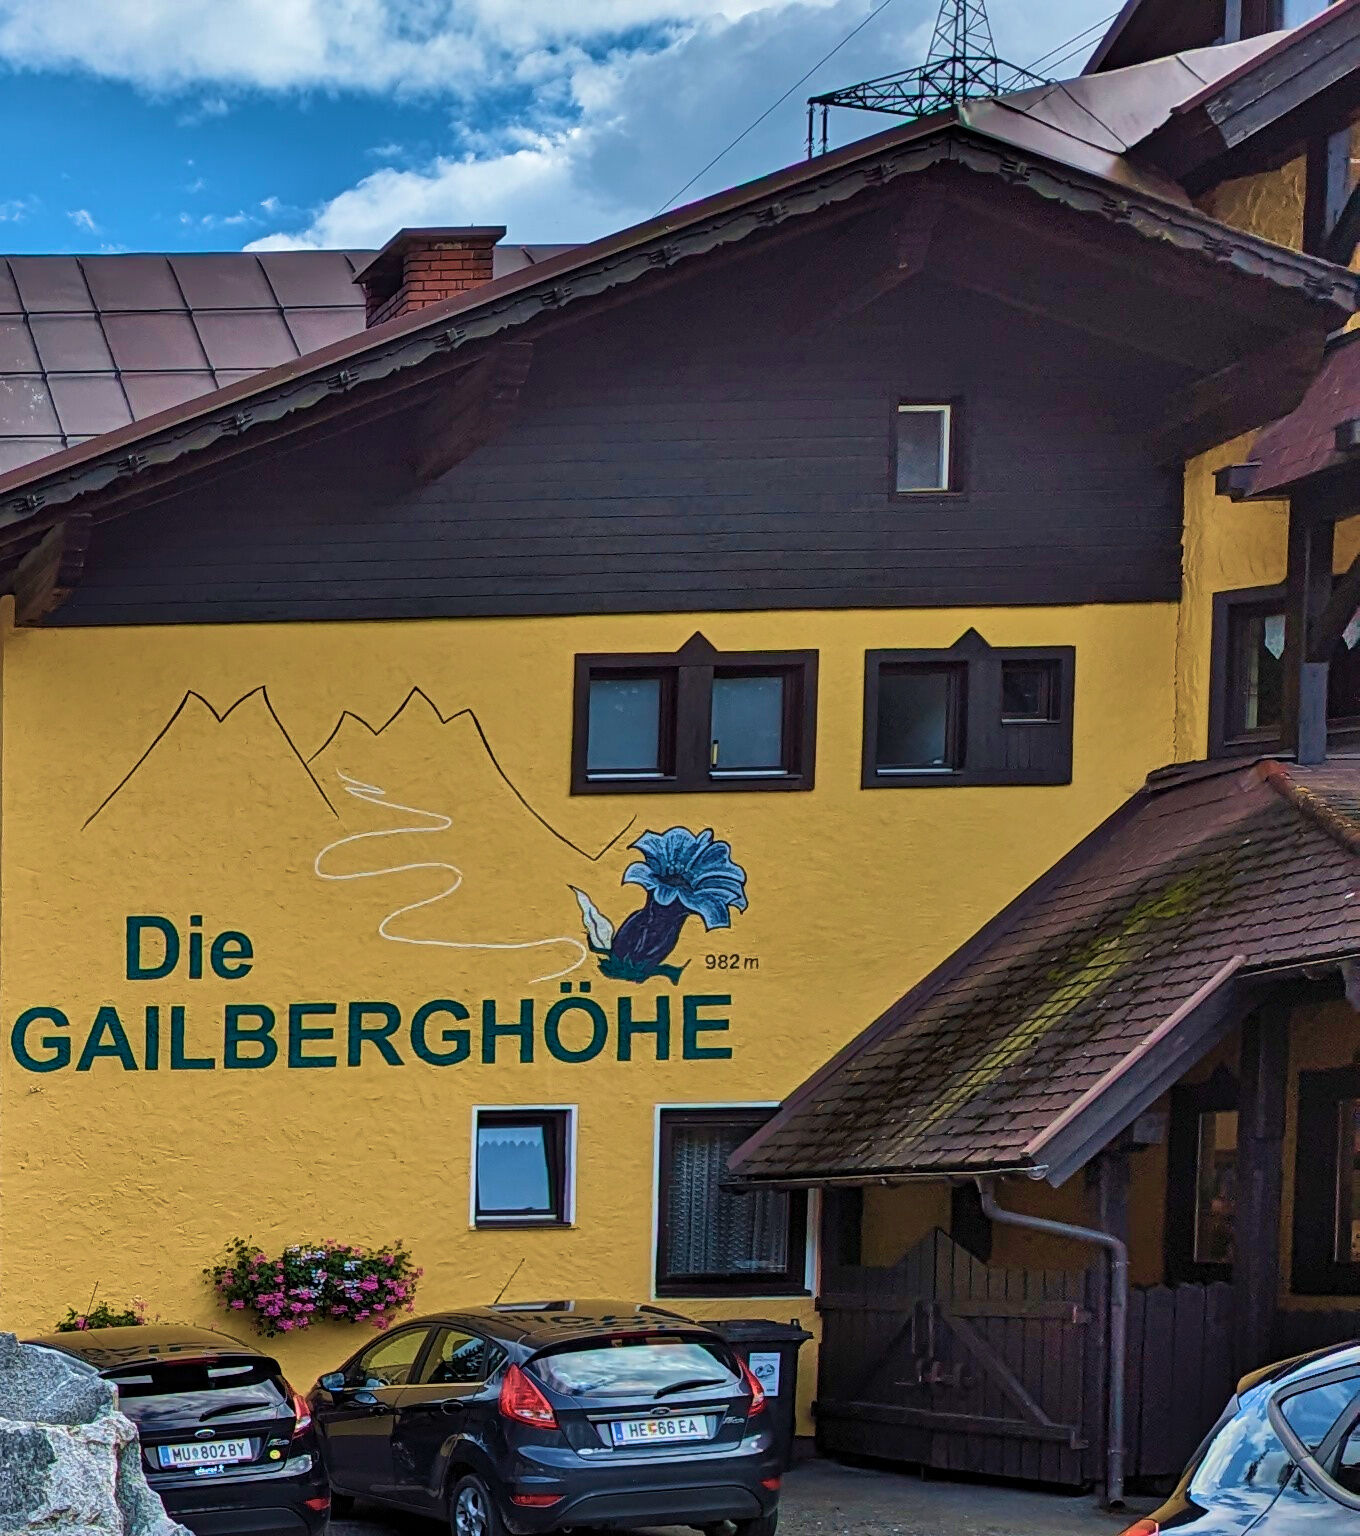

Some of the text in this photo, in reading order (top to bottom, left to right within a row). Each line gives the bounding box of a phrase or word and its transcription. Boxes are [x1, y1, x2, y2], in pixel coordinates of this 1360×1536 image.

[125, 914, 254, 981] Die
[705, 953, 759, 970] 982 m
[10, 980, 734, 1074] GAILBERGHÖHE
[629, 1422, 649, 1438] HE
[678, 1419, 698, 1433] EA
